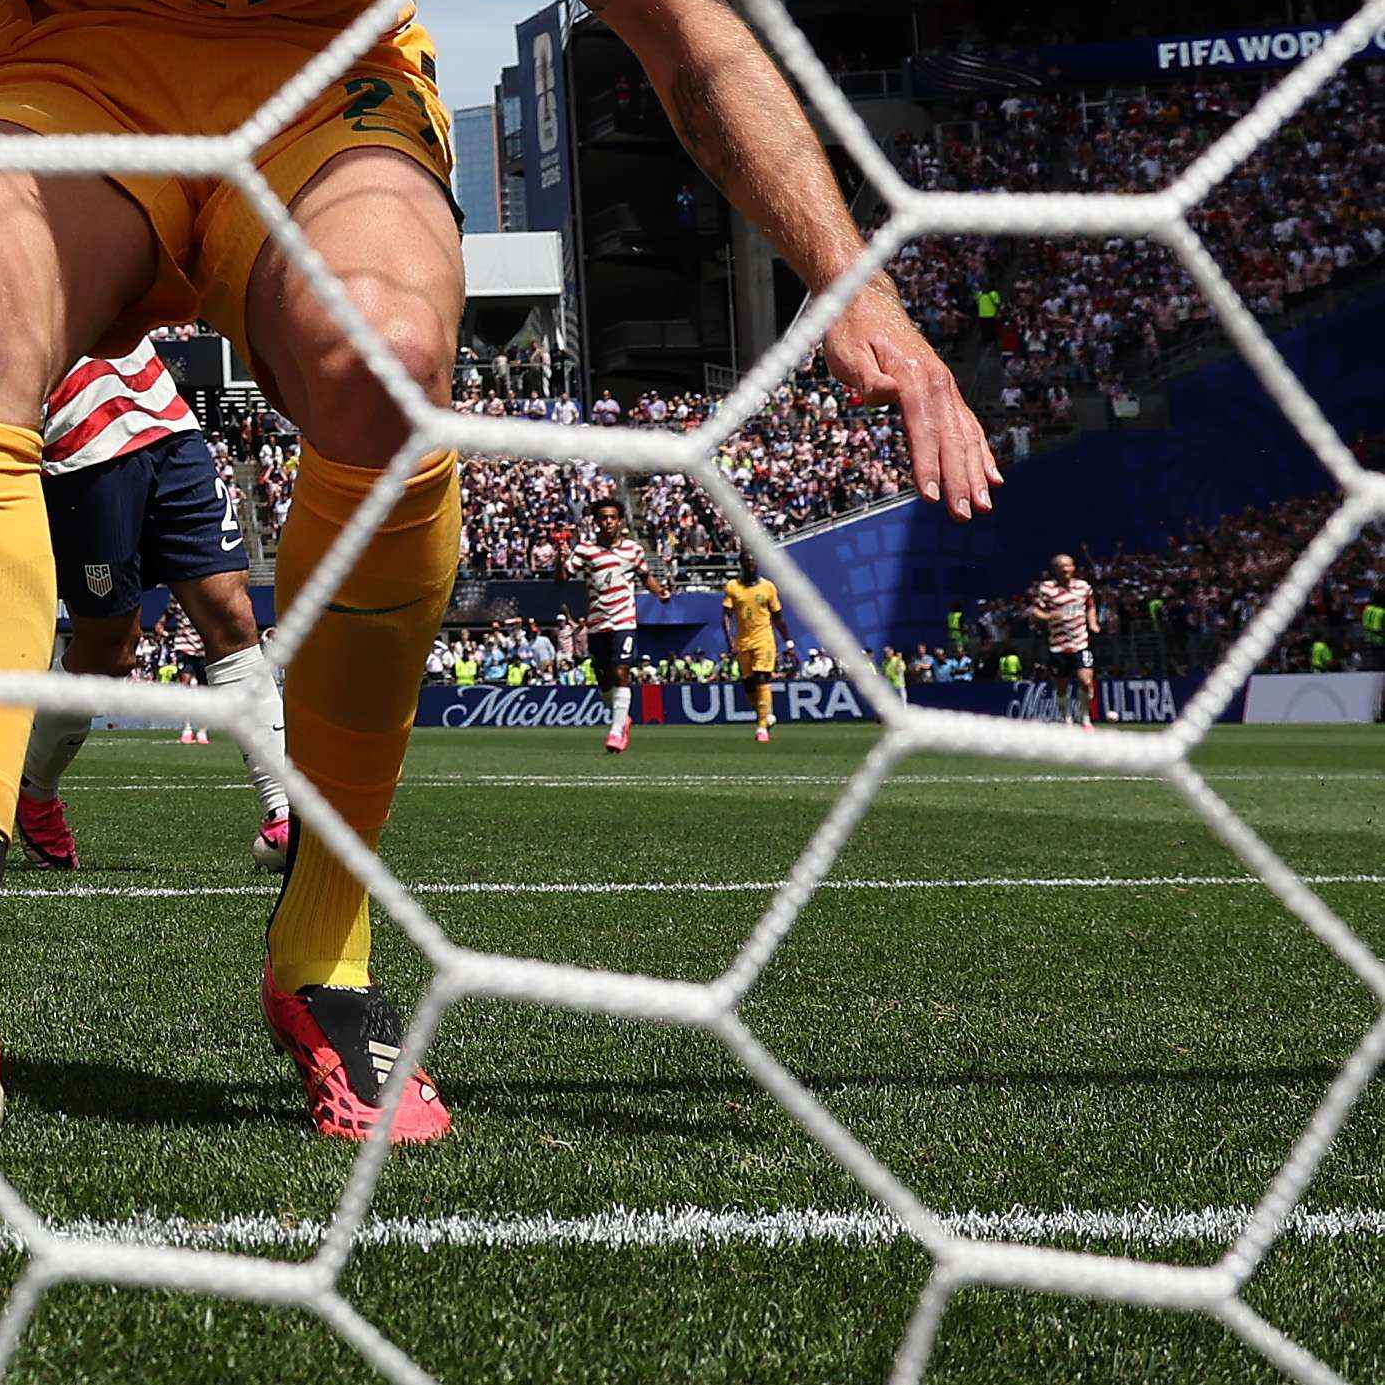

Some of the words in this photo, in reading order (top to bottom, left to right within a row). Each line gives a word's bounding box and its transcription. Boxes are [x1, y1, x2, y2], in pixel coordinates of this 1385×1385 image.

[1157, 38, 1235, 69] FIFA
[1237, 30, 1341, 62] WOR
[86, 567, 109, 579] USA
[442, 686, 614, 728] Michelo
[1101, 679, 1176, 721] ULTRA
